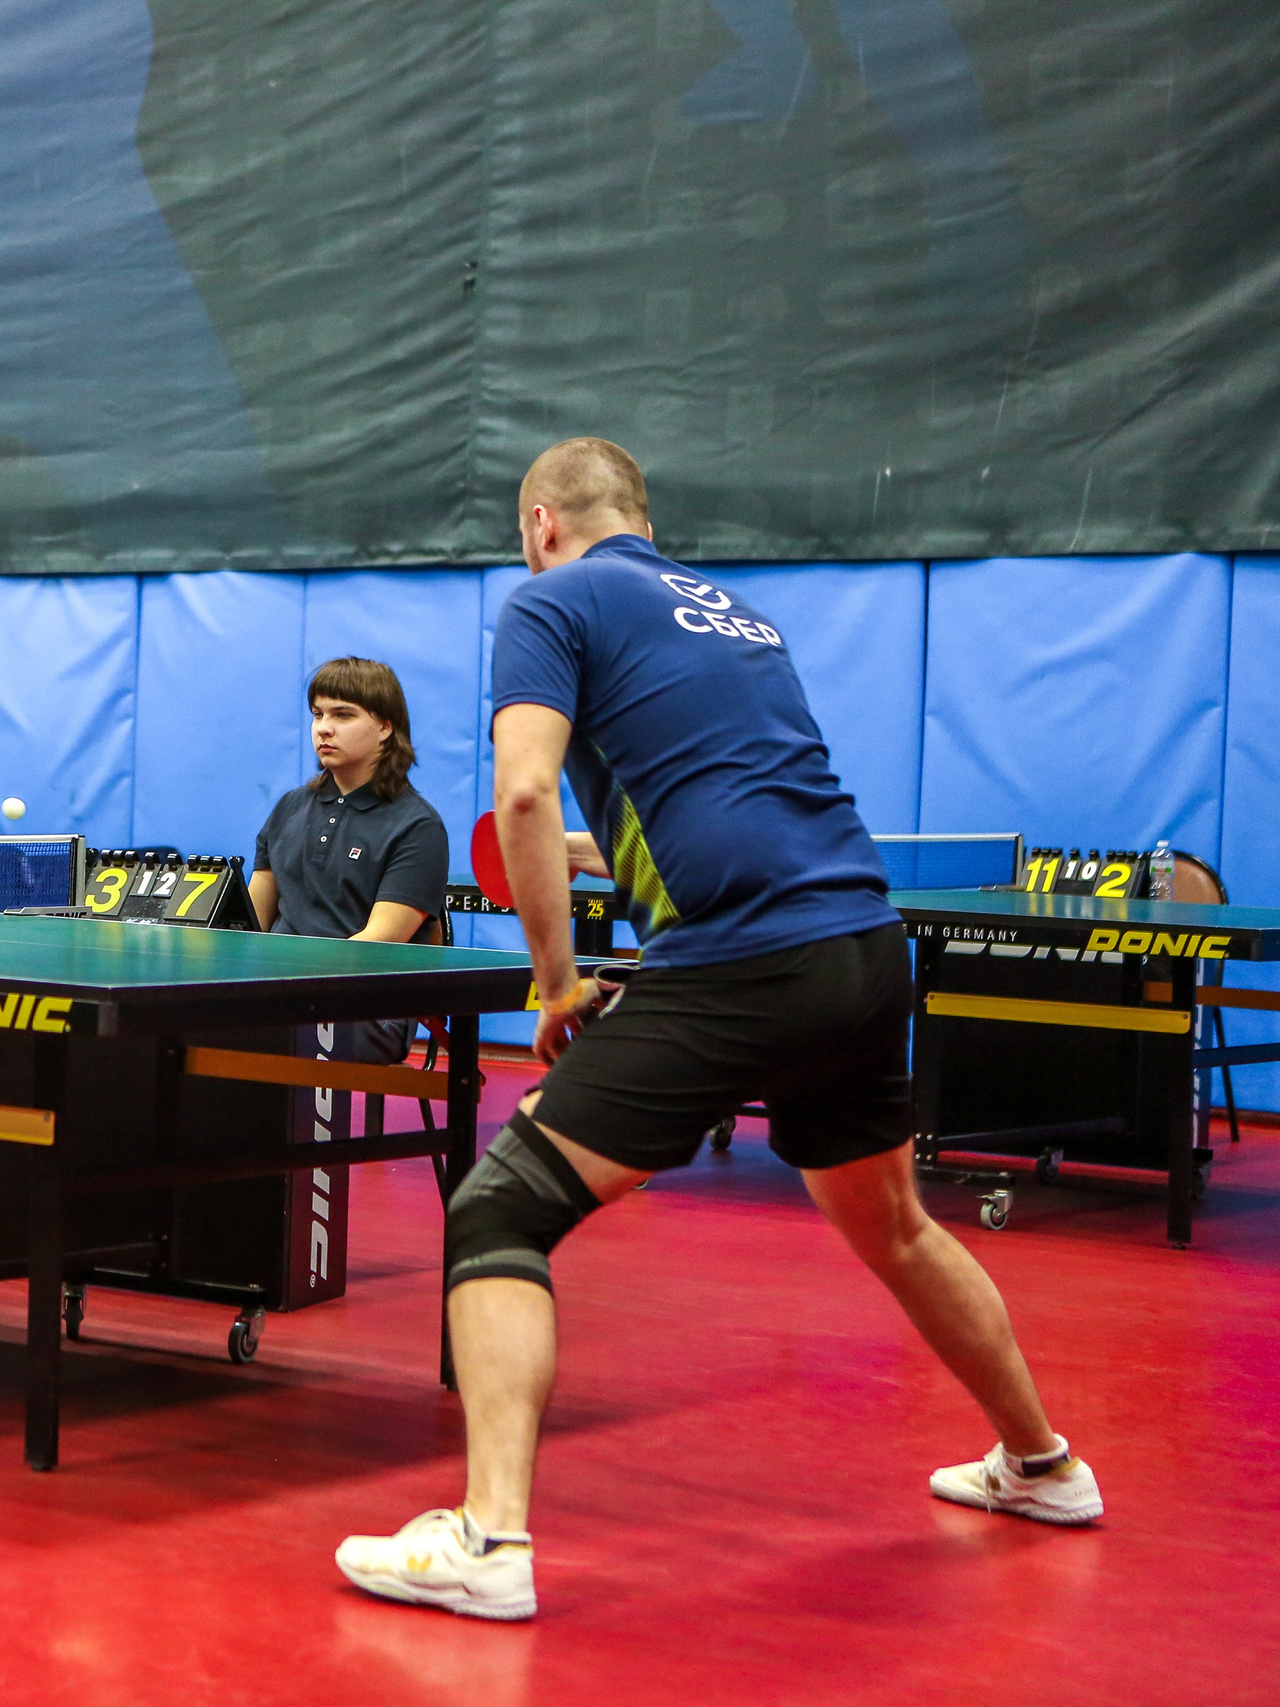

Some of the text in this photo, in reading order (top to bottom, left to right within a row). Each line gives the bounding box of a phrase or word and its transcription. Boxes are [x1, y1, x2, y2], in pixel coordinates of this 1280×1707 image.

[673, 606, 782, 647] СБЕР
[85, 868, 218, 917] 3 1 2 7
[1026, 857, 1132, 898] 11 1 0 2
[587, 902, 605, 918] 25
[917, 925, 933, 937] IN
[942, 926, 1019, 943] GERMANY
[1086, 928, 1233, 960] DONIC
